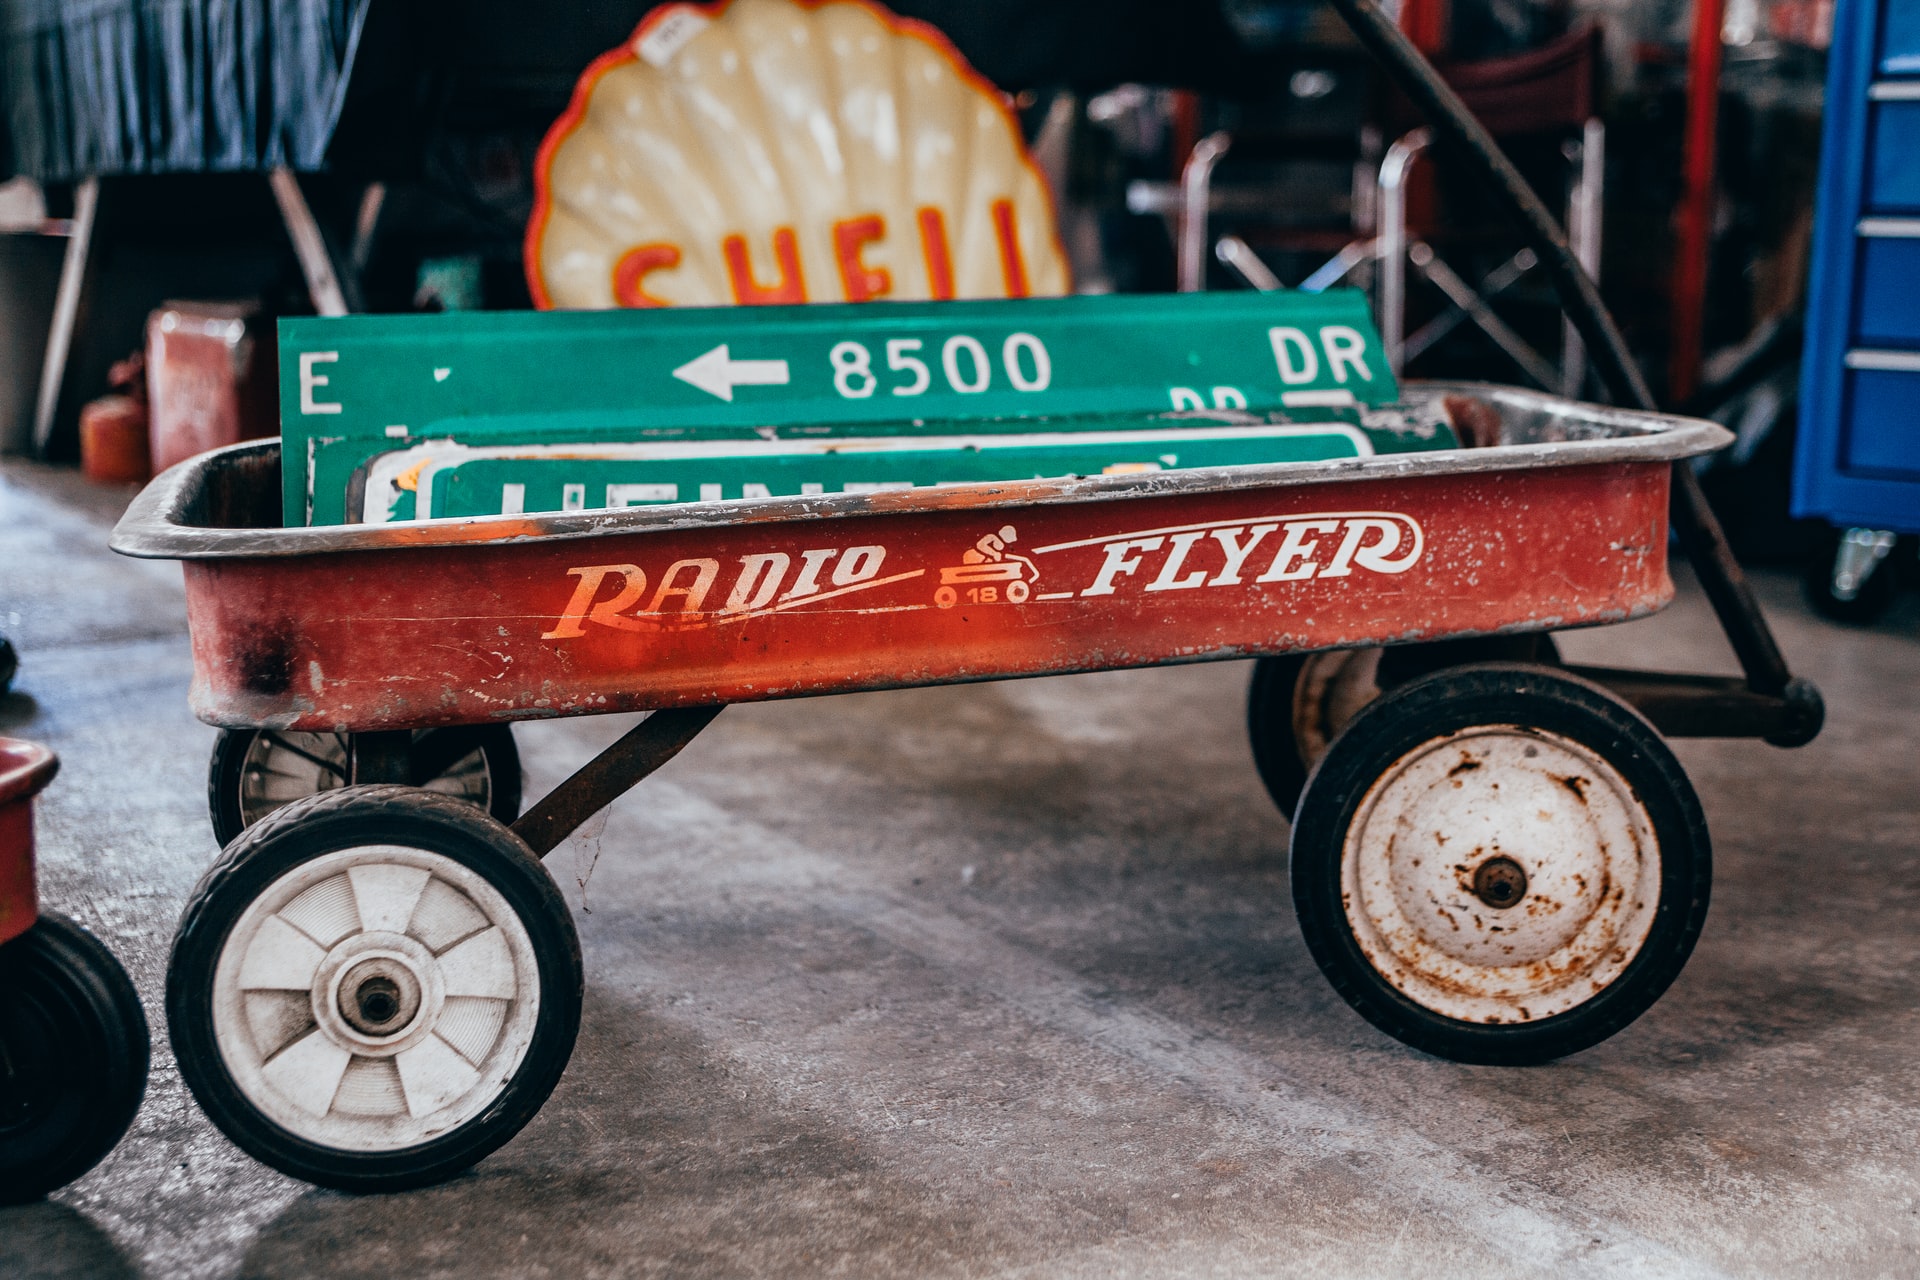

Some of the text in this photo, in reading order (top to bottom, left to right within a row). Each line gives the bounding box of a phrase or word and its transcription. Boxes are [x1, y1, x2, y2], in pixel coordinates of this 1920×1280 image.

[299, 325, 1373, 414] E 8500 DR
[541, 512, 1424, 640] RADIO FLYER
[966, 586, 998, 603] 18
